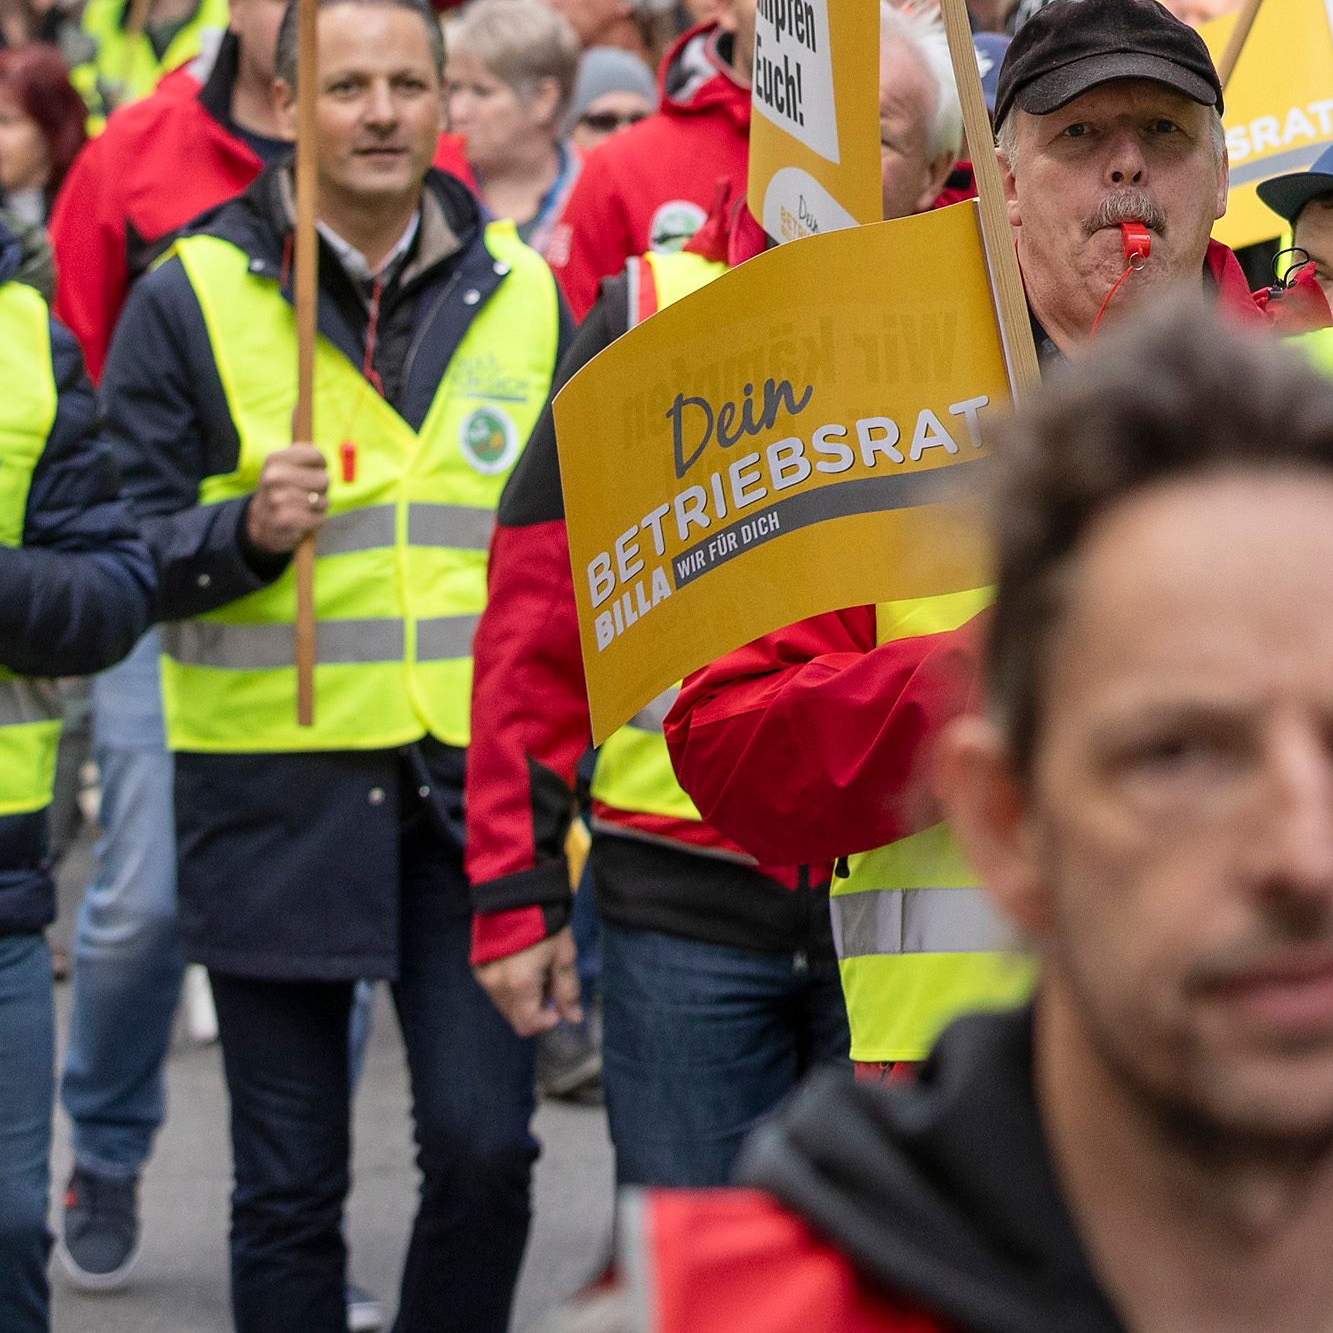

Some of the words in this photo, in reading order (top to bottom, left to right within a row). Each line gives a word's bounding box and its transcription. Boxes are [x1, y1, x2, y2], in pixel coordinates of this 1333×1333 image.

[756, 32, 804, 127] Euch!
[665, 377, 814, 480] Dein
[586, 394, 990, 610] BETRIEBSRAT
[593, 568, 673, 653] BILLA
[677, 548, 707, 580] WIR
[708, 529, 739, 562] FÜR
[740, 511, 781, 547] DICH
